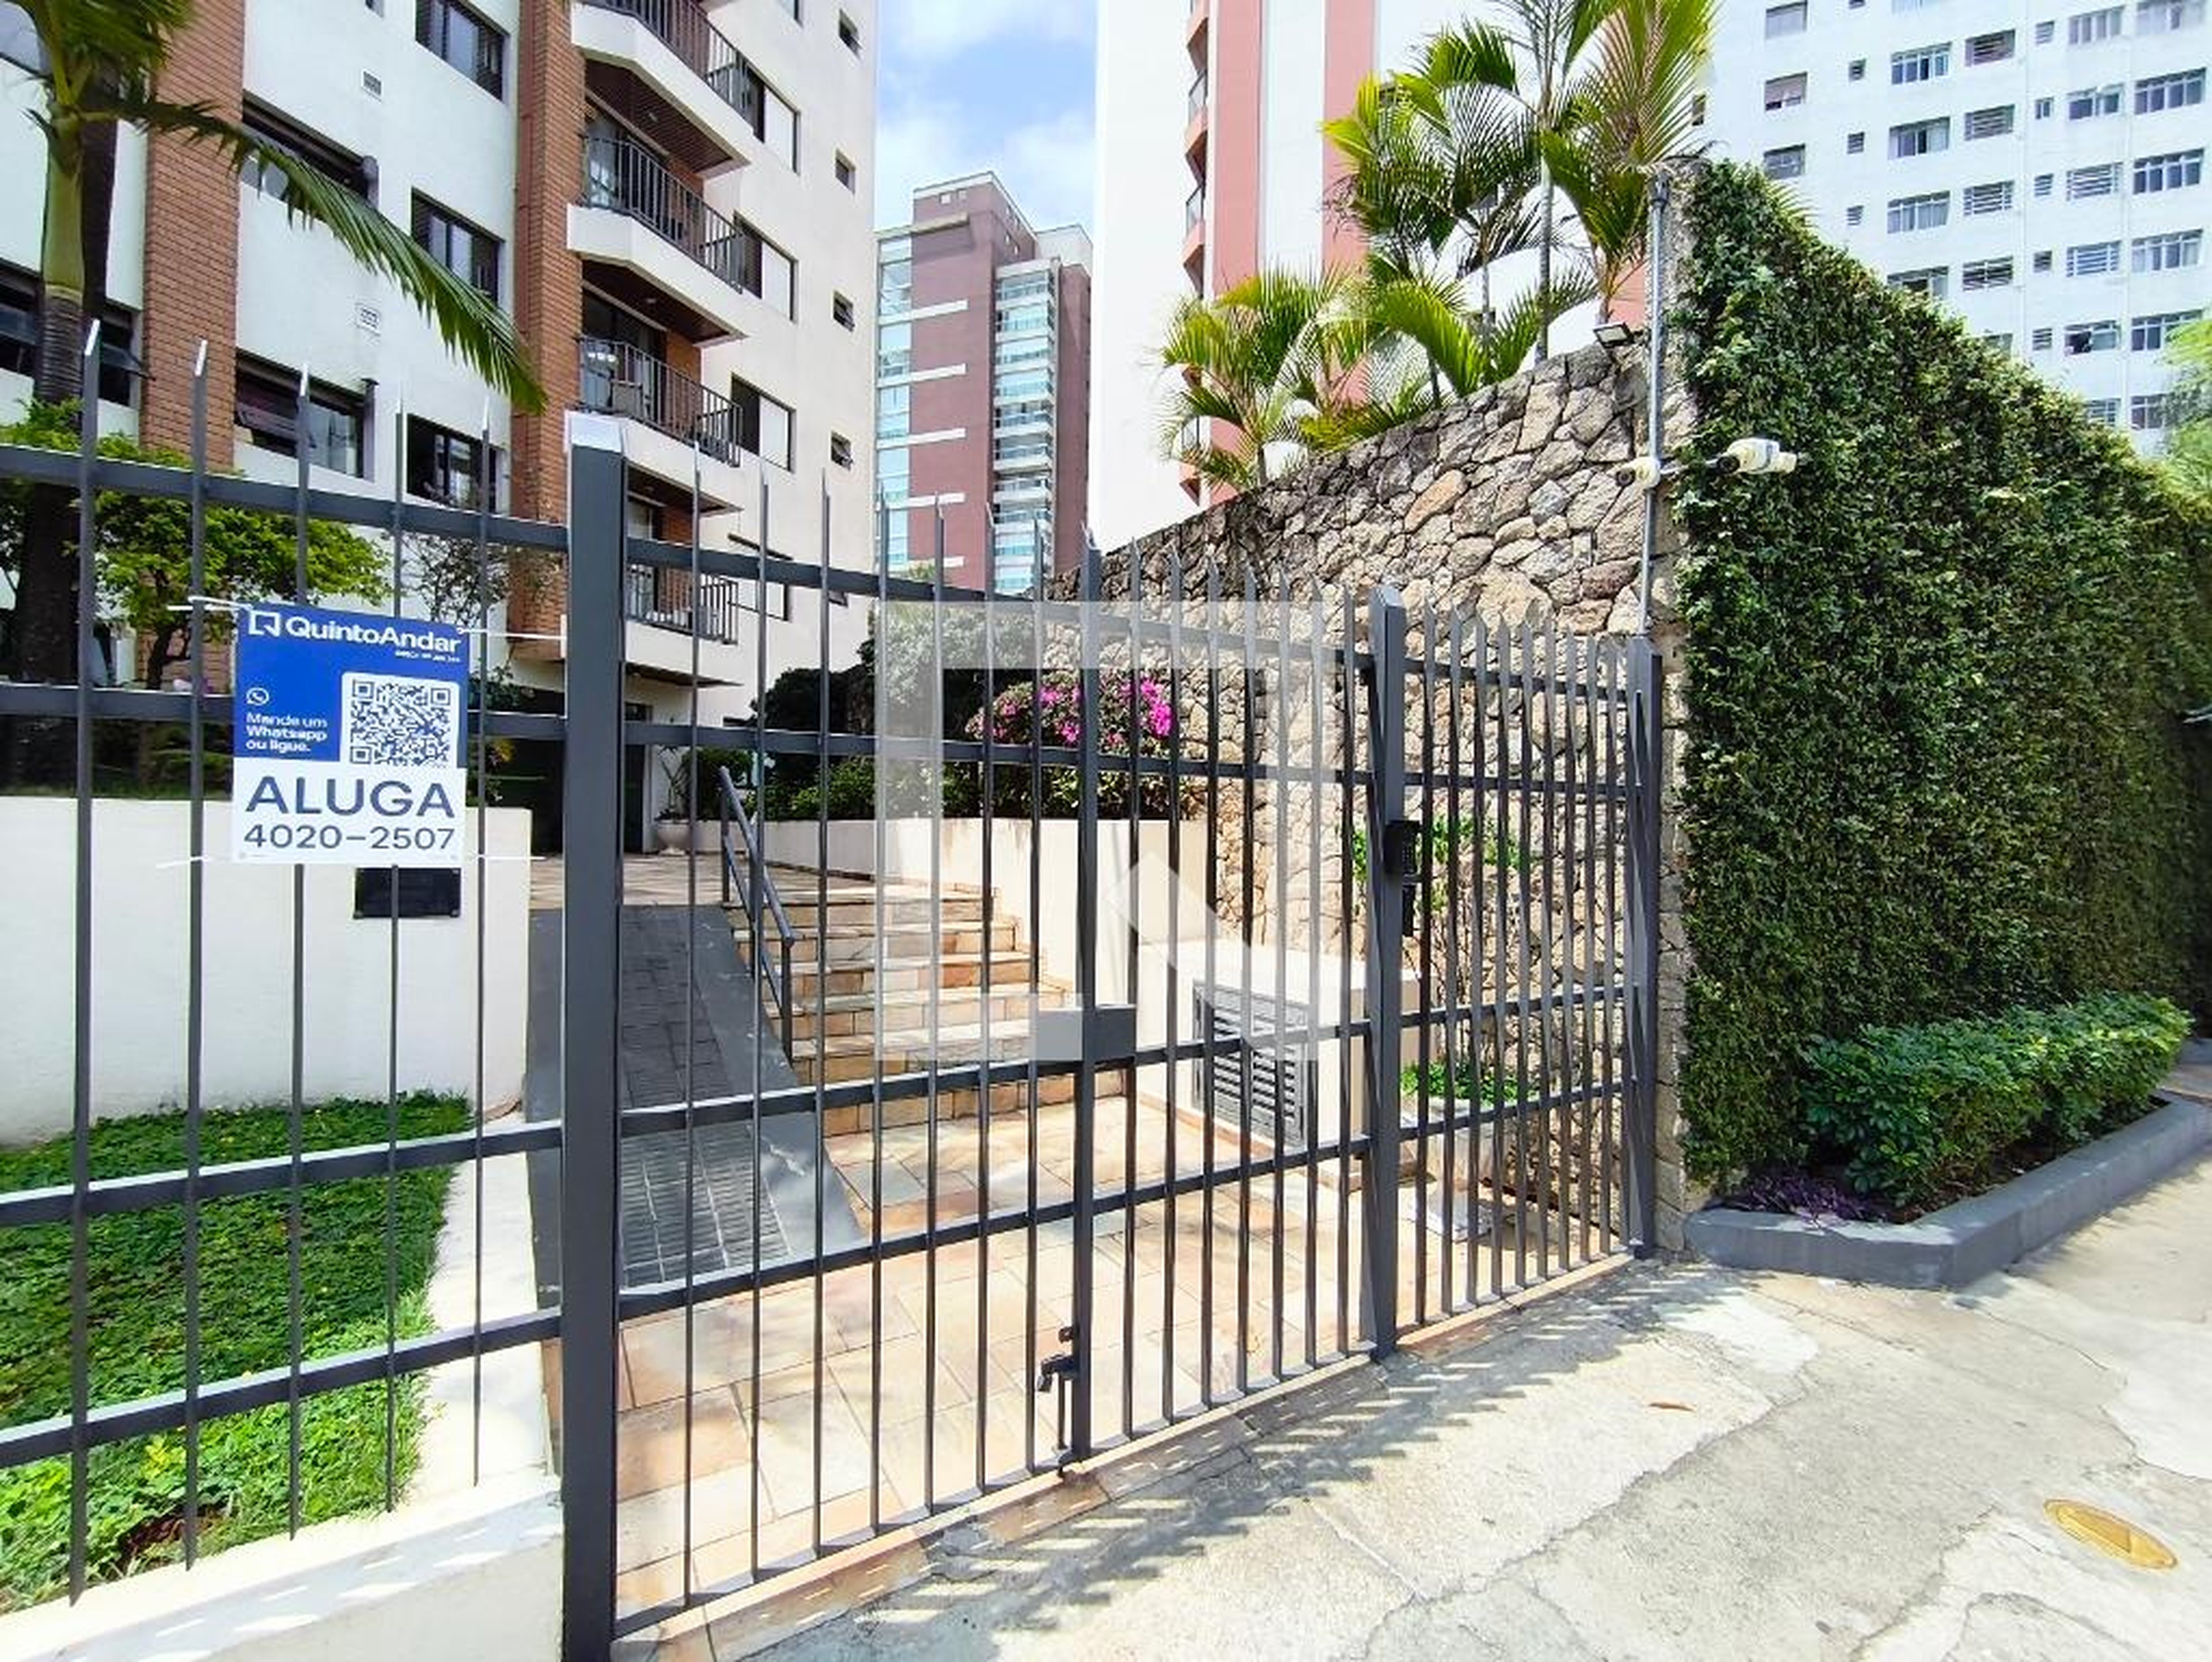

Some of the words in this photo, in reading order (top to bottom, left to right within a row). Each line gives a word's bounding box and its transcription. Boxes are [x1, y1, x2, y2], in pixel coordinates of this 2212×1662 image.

[286, 617, 461, 652] QuintoAndar
[246, 712, 300, 726] Mande
[302, 718, 328, 728] um
[245, 739, 267, 750] ou
[270, 739, 311, 754] ligue.
[245, 776, 456, 818] ALUGA
[244, 824, 455, 850] 4020-2507
